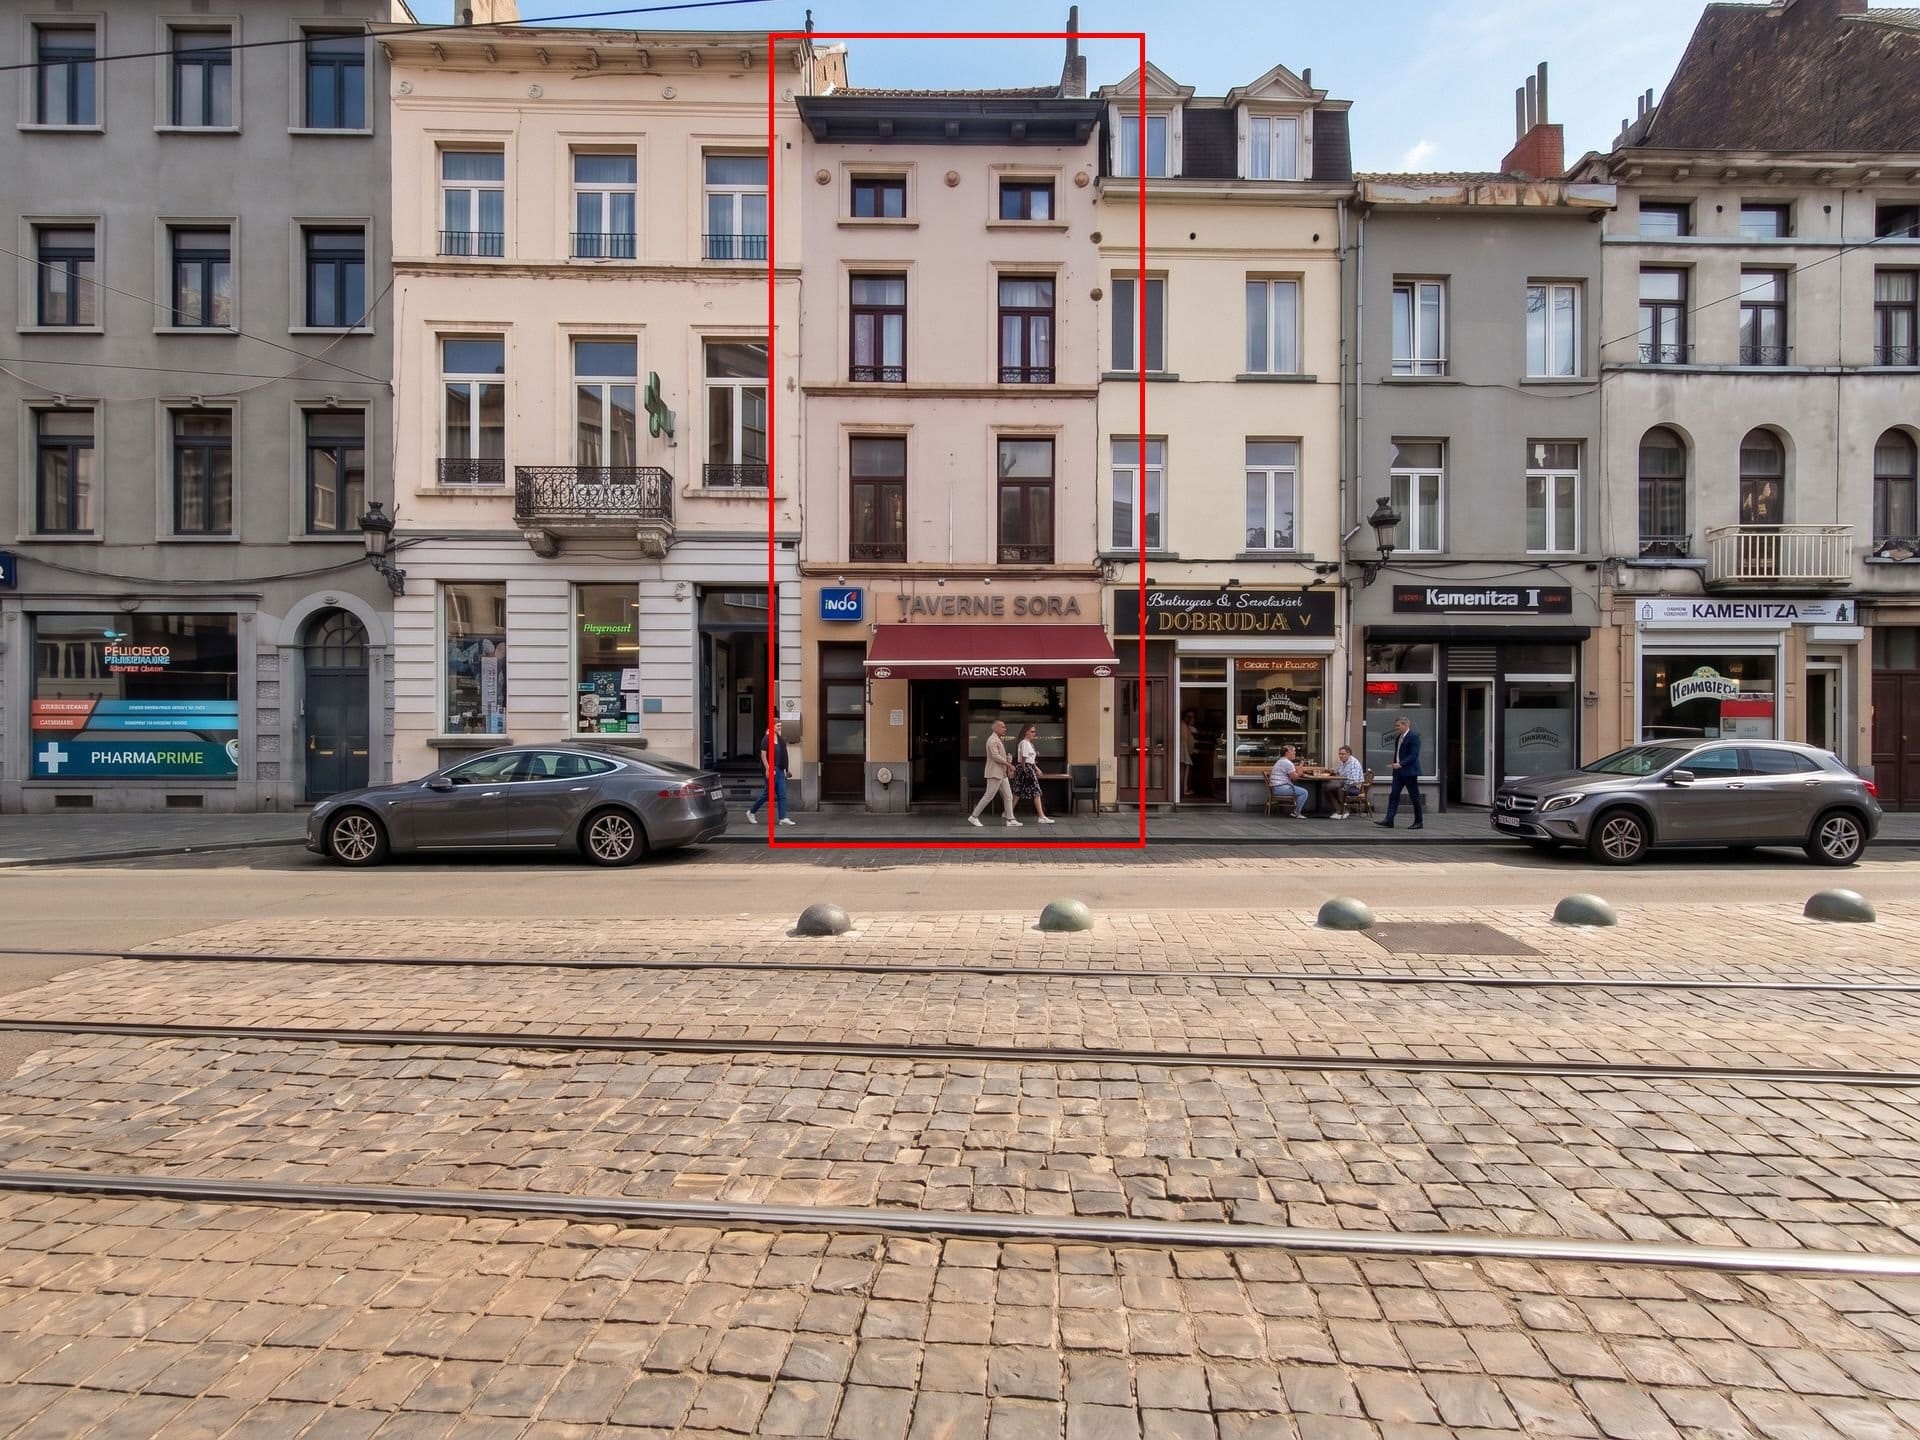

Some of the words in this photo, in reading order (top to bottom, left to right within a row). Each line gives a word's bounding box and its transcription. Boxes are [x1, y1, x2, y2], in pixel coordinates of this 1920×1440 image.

[897, 595, 1005, 616] TAVERNE
[1013, 595, 1081, 616] SORA
[1425, 588, 1519, 606] Kamenitza
[1691, 603, 1799, 619] KAMENITZA
[1158, 612, 1291, 632] DOBRUDJA
[955, 666, 999, 677] TAVERNE
[1000, 666, 1026, 677] SORA
[90, 751, 204, 764] PHARMAPRIME
